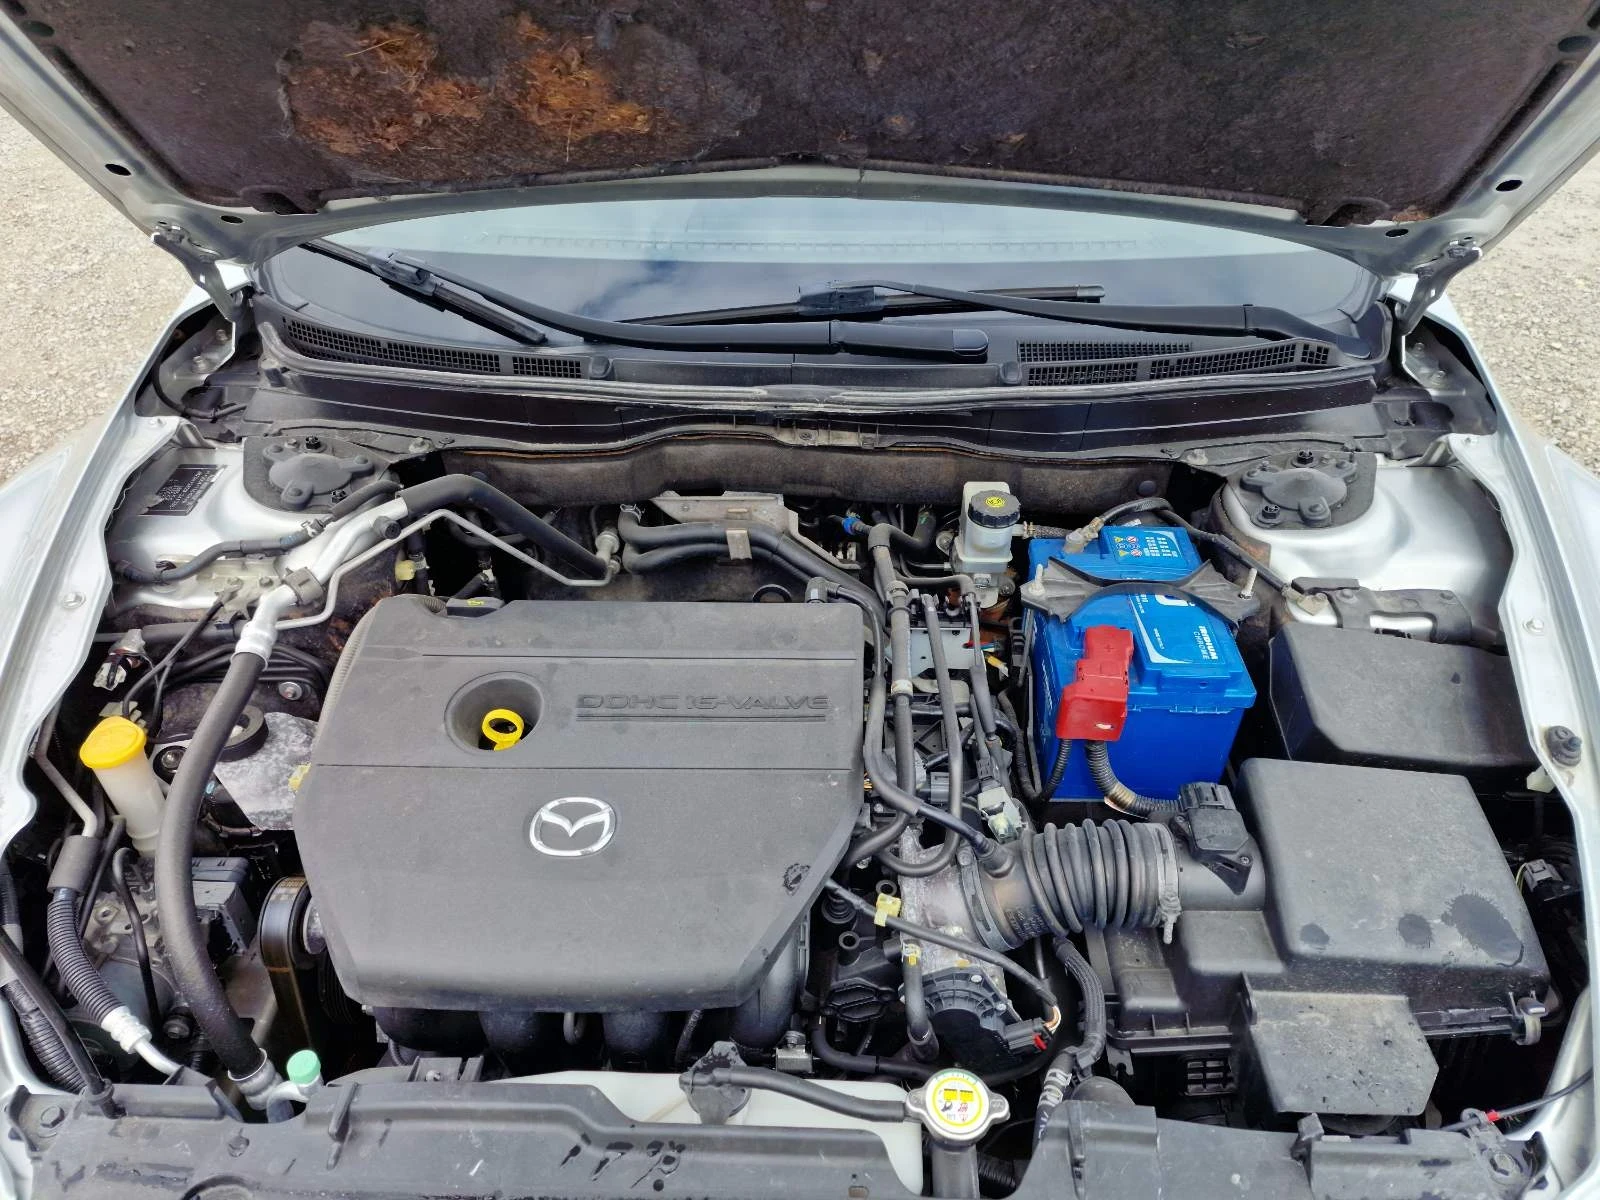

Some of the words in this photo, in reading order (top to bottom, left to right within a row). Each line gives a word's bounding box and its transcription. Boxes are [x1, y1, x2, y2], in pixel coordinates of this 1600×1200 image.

[1199, 625, 1218, 660] IRIDIUM
[576, 695, 680, 710] DOHC
[686, 695, 830, 710] 16-VALVE
